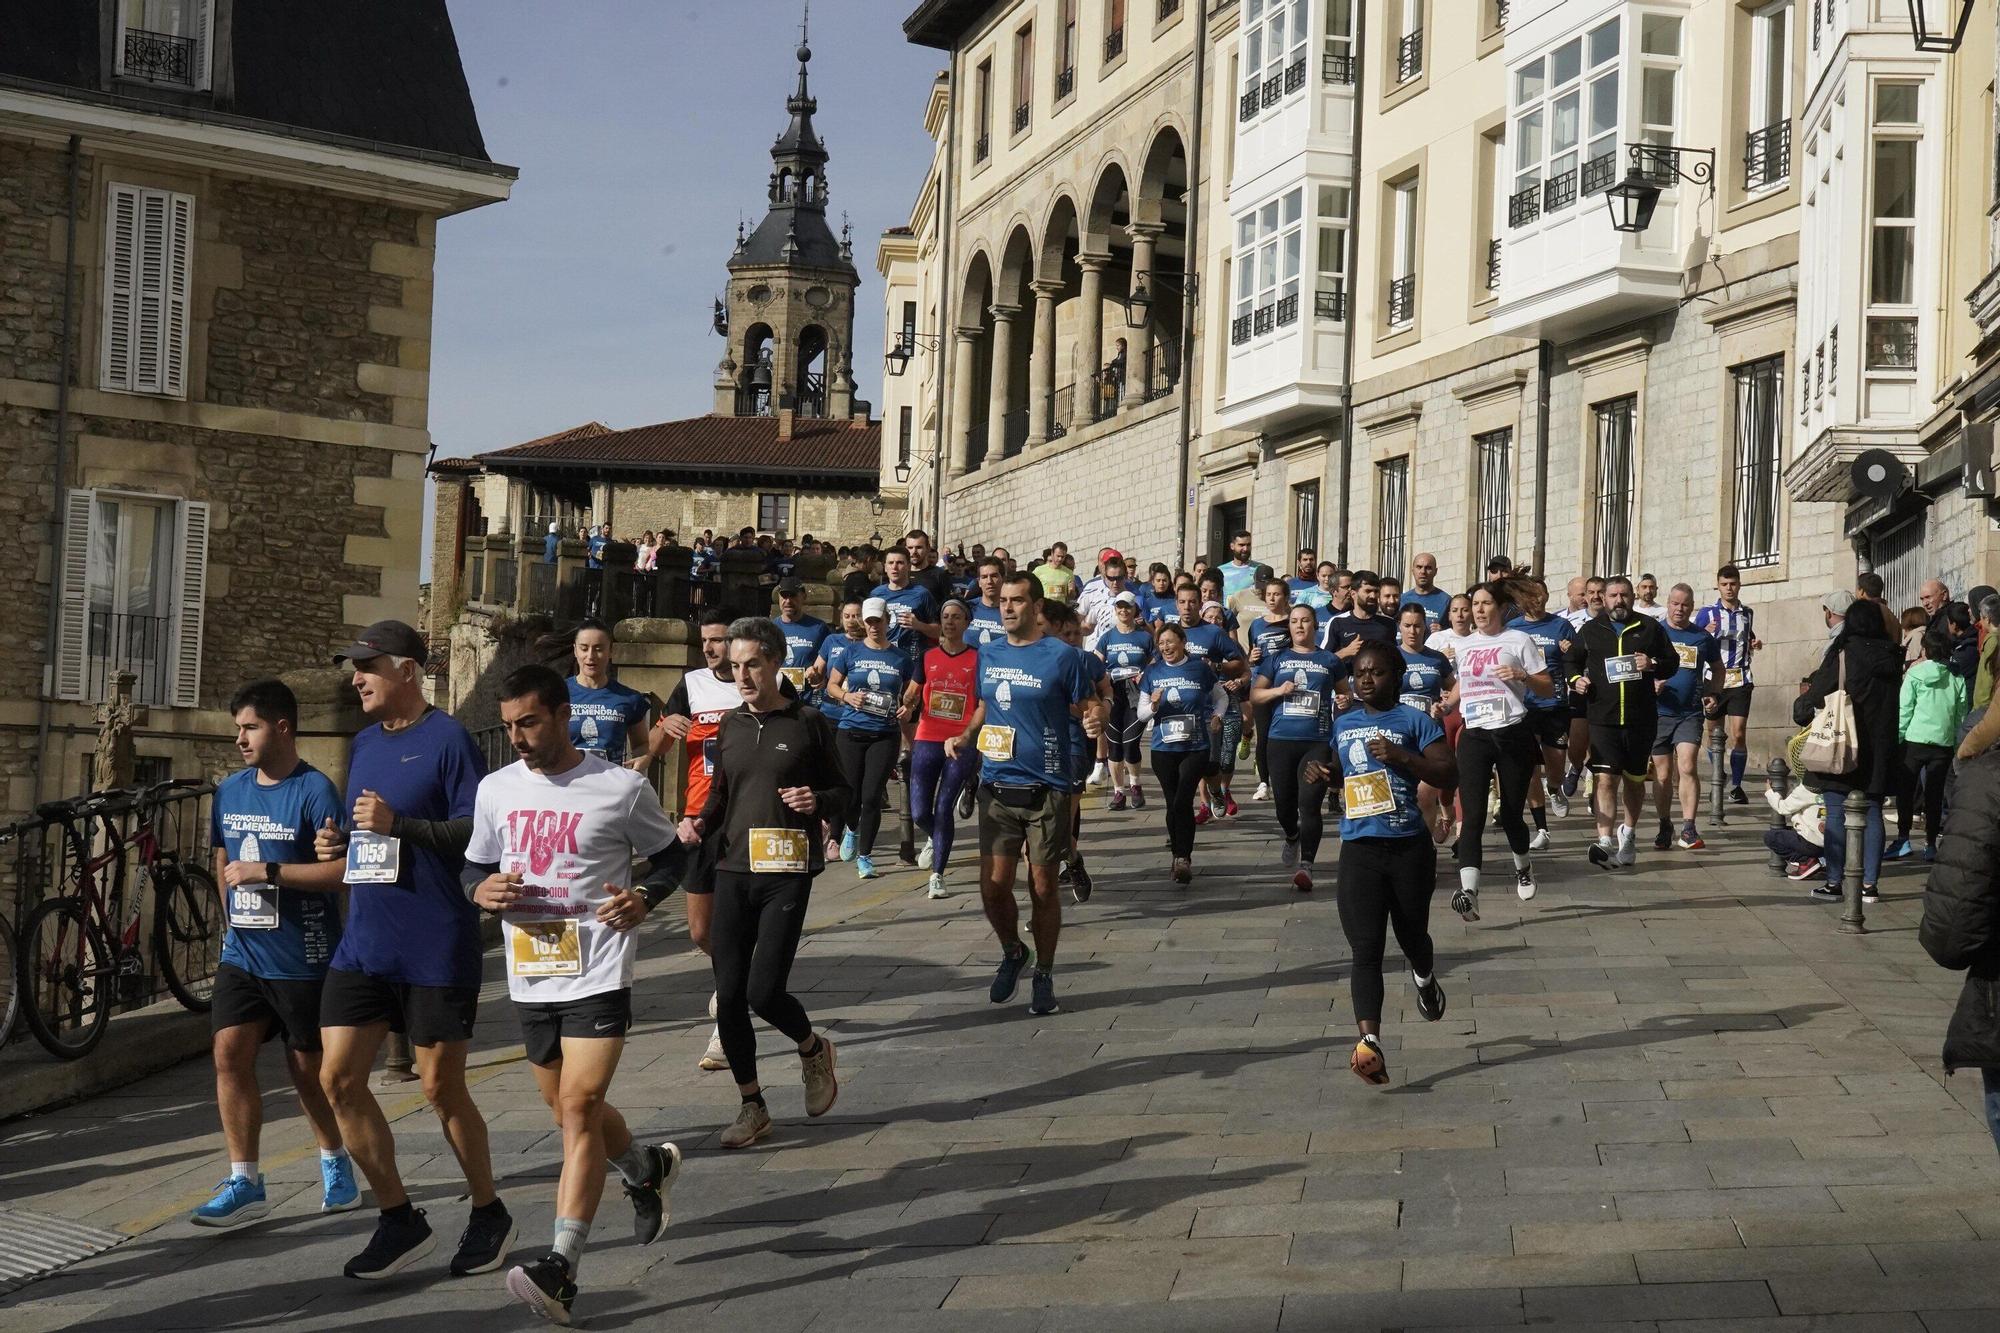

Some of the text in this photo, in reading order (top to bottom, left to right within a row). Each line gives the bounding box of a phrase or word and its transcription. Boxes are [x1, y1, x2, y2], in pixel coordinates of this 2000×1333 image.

[1615, 661, 1632, 673] 975
[990, 672, 1033, 682] ALMENDRA
[571, 708, 618, 716] ALMENDRA
[985, 733, 1003, 748] 293
[1353, 784, 1375, 802] 112
[223, 812, 271, 823] LA CONQUISTA
[231, 821, 283, 833] ALMENDRA
[507, 809, 584, 855] 170K
[258, 832, 295, 841] KONKISTA
[356, 842, 388, 864] 1053
[766, 839, 794, 856] 315
[234, 891, 262, 910] 899
